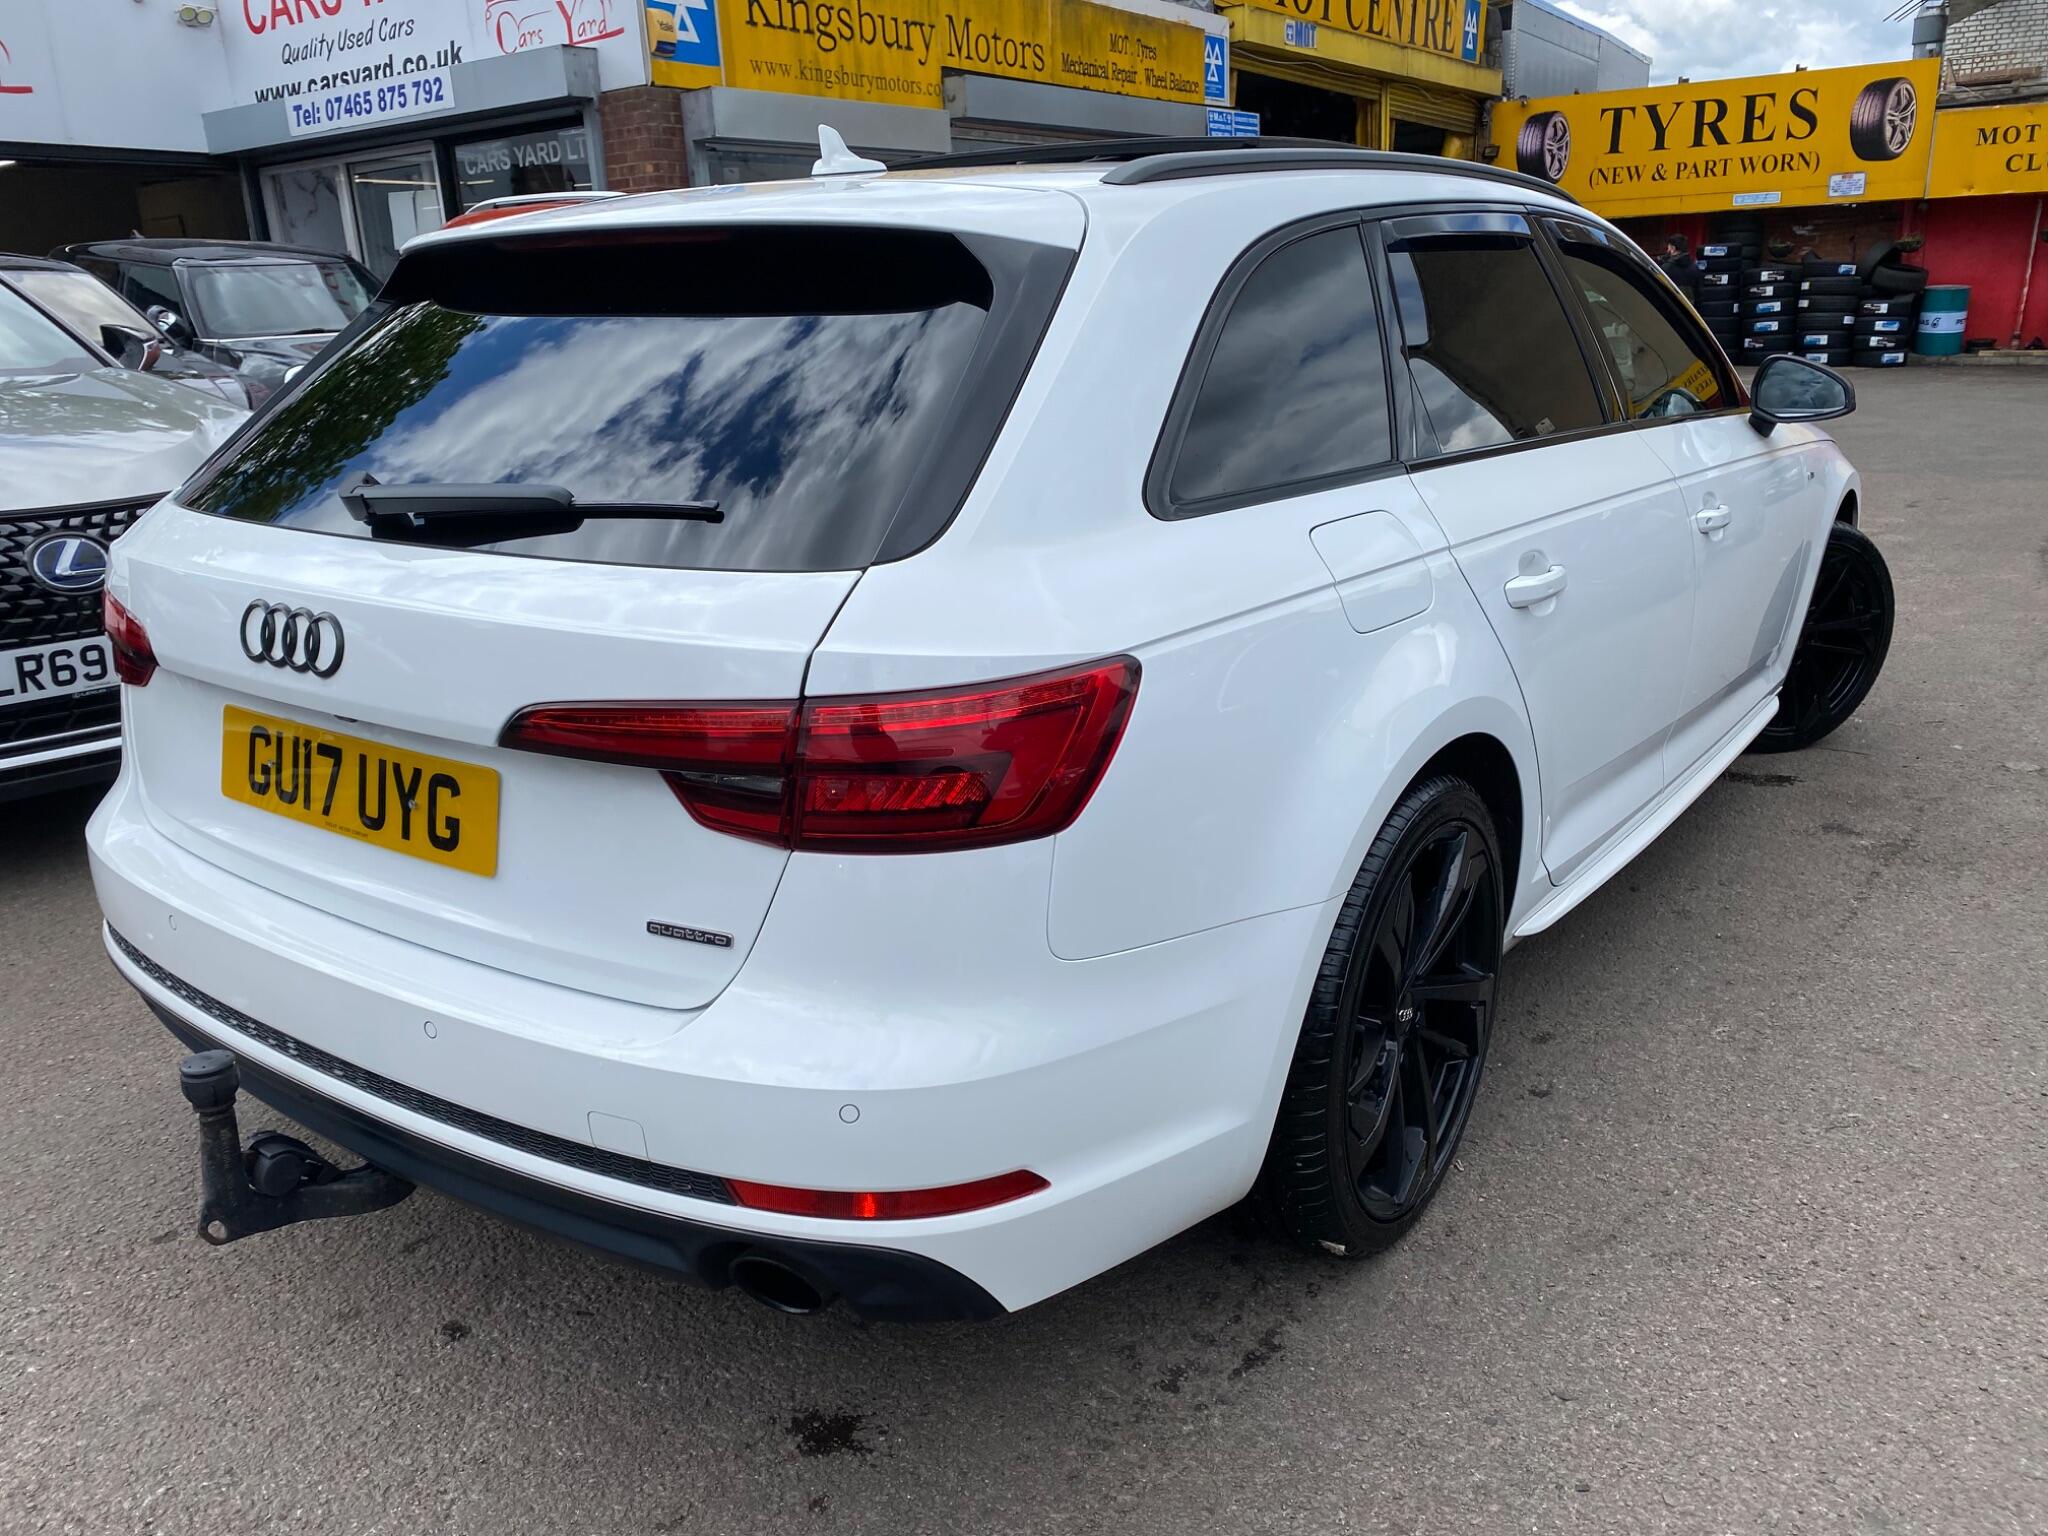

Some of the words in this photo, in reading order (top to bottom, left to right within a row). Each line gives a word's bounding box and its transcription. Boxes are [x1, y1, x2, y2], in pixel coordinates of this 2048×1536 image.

[281, 34, 335, 65] Quality
[337, 19, 374, 52] Used
[378, 17, 415, 43] Cars
[496, 10, 544, 54] Cars
[746, 0, 935, 66] Kingsbury
[945, 14, 1045, 72] Motors
[1109, 33, 1130, 55] MOT
[1136, 38, 1157, 62] Tyres
[1294, 20, 1317, 48] MOT
[1061, 52, 1109, 80] Mechanical
[1112, 62, 1138, 88] Repair
[1144, 67, 1168, 91] Wheel
[1169, 72, 1200, 95] Balance
[293, 104, 321, 127] Tel:
[325, 90, 373, 122] 07465
[378, 83, 408, 113] 875
[412, 76, 444, 107] 792
[1600, 87, 1819, 155] TYRES
[1976, 123, 2042, 147] MOT
[464, 149, 511, 176] CARS
[513, 141, 562, 168] YARD
[1589, 164, 1647, 190] (NEW
[1651, 162, 1668, 182] &
[1676, 157, 1733, 181] PART
[1734, 150, 1821, 174] WORN)
[2005, 152, 2048, 173] CL
[0, 643, 109, 697] R69
[248, 725, 343, 818] GU17
[358, 753, 462, 853] UYG
[649, 922, 728, 946] quattro
